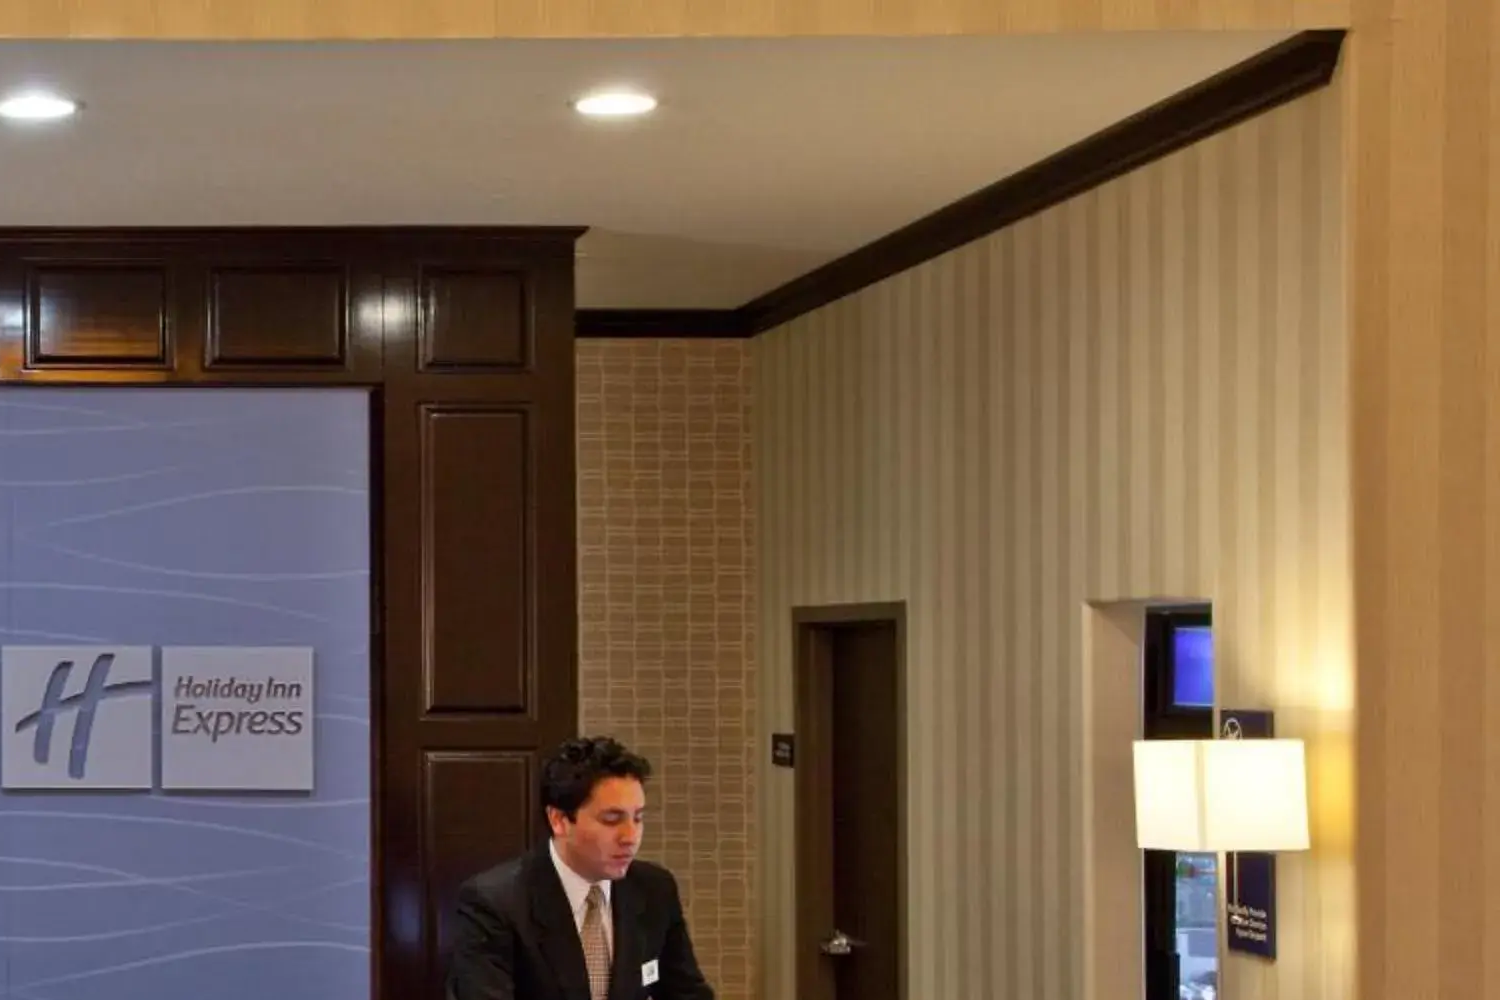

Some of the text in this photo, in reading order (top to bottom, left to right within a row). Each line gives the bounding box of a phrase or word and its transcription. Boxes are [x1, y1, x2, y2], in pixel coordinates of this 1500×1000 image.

[174, 675, 303, 705] Holiday Inn
[171, 703, 304, 743] Express
